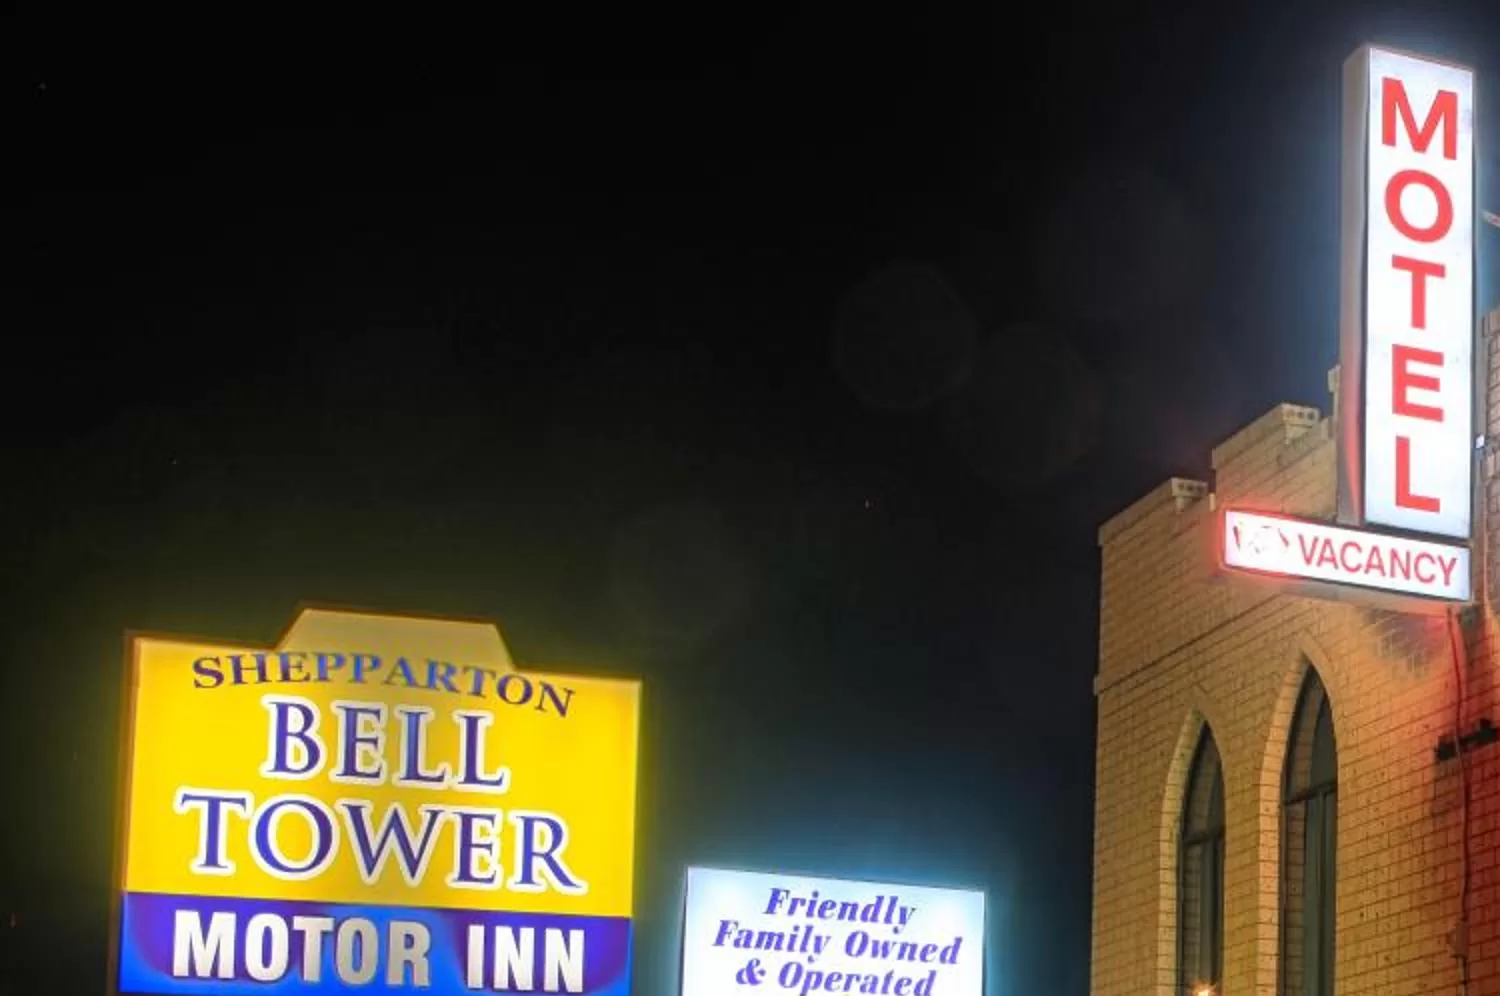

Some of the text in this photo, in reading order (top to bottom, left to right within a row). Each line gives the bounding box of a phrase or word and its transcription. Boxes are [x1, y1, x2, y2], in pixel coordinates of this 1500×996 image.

[1382, 76, 1459, 514] MOTEL
[1298, 534, 1458, 587] VACANCY
[192, 651, 576, 718] SHEPPARTON
[266, 698, 506, 789] BELL
[178, 791, 583, 890] TOWER
[712, 918, 963, 965] Family Owned
[763, 887, 917, 935] Friendly
[172, 909, 586, 993] MOTOR INN
[735, 957, 767, 987] &
